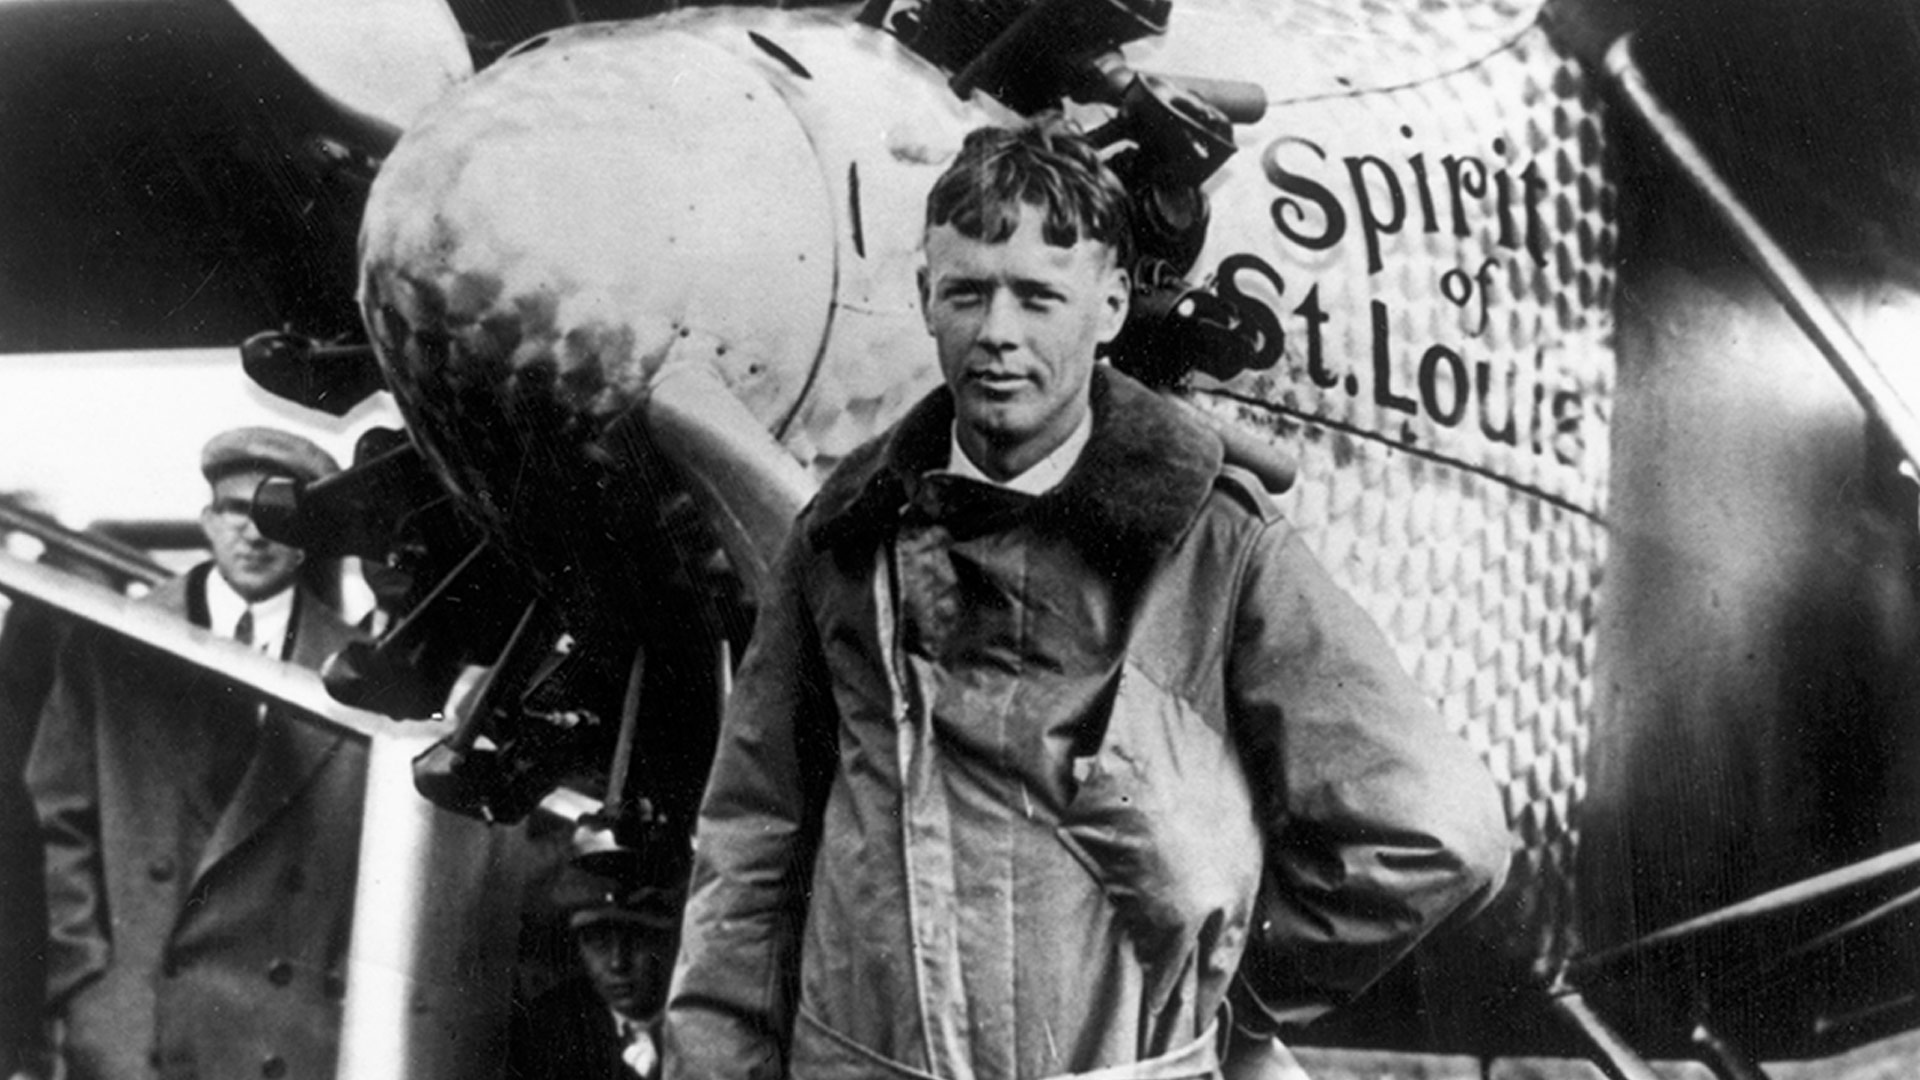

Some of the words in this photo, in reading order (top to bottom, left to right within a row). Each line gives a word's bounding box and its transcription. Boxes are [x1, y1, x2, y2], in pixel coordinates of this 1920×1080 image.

[1262, 124, 1550, 275] Spirit
[1216, 253, 1359, 398] St.
[1440, 257, 1500, 339] of
